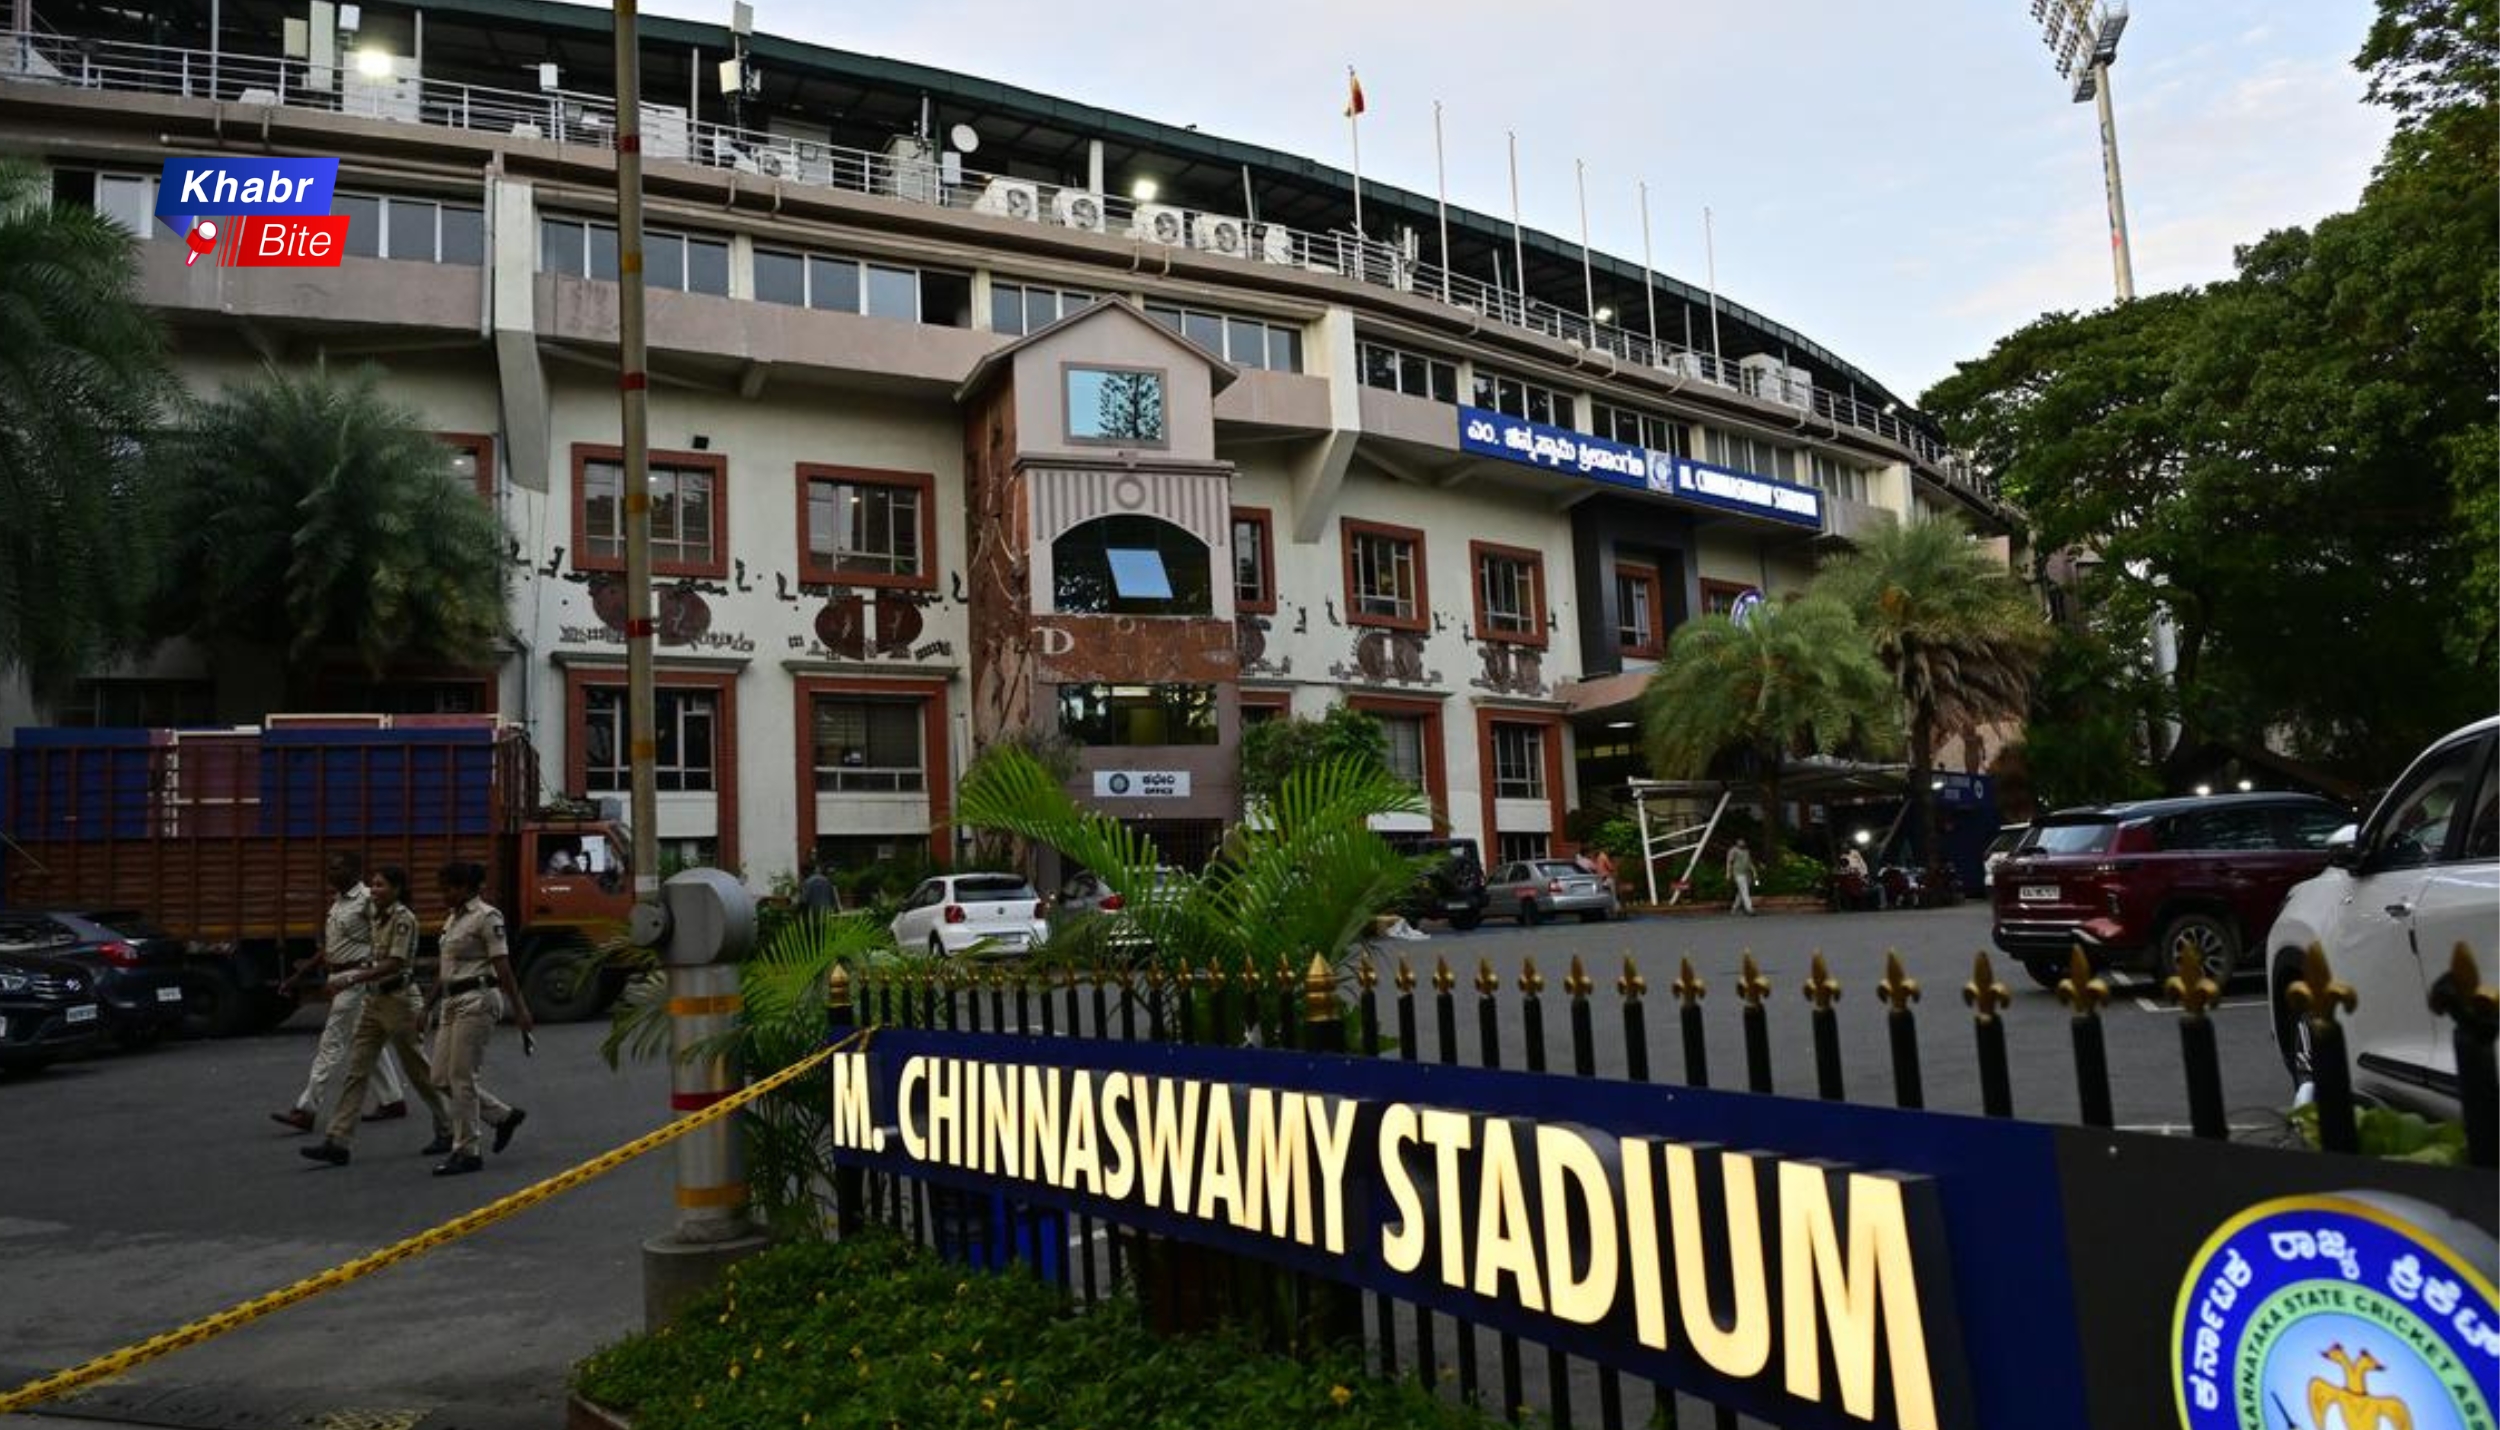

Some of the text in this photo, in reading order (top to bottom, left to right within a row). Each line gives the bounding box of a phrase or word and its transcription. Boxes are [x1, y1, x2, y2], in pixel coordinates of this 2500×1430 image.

[833, 1052, 1938, 1430] M. CHINNASWAMY STADIUM
[2188, 1248, 2252, 1410] ಕರ್ನಾಟಕ
[2269, 1228, 2361, 1280] ರಾಜ್ಯ
[2283, 1288, 2347, 1313] STATE
[2353, 1295, 2455, 1372] CRICKET
